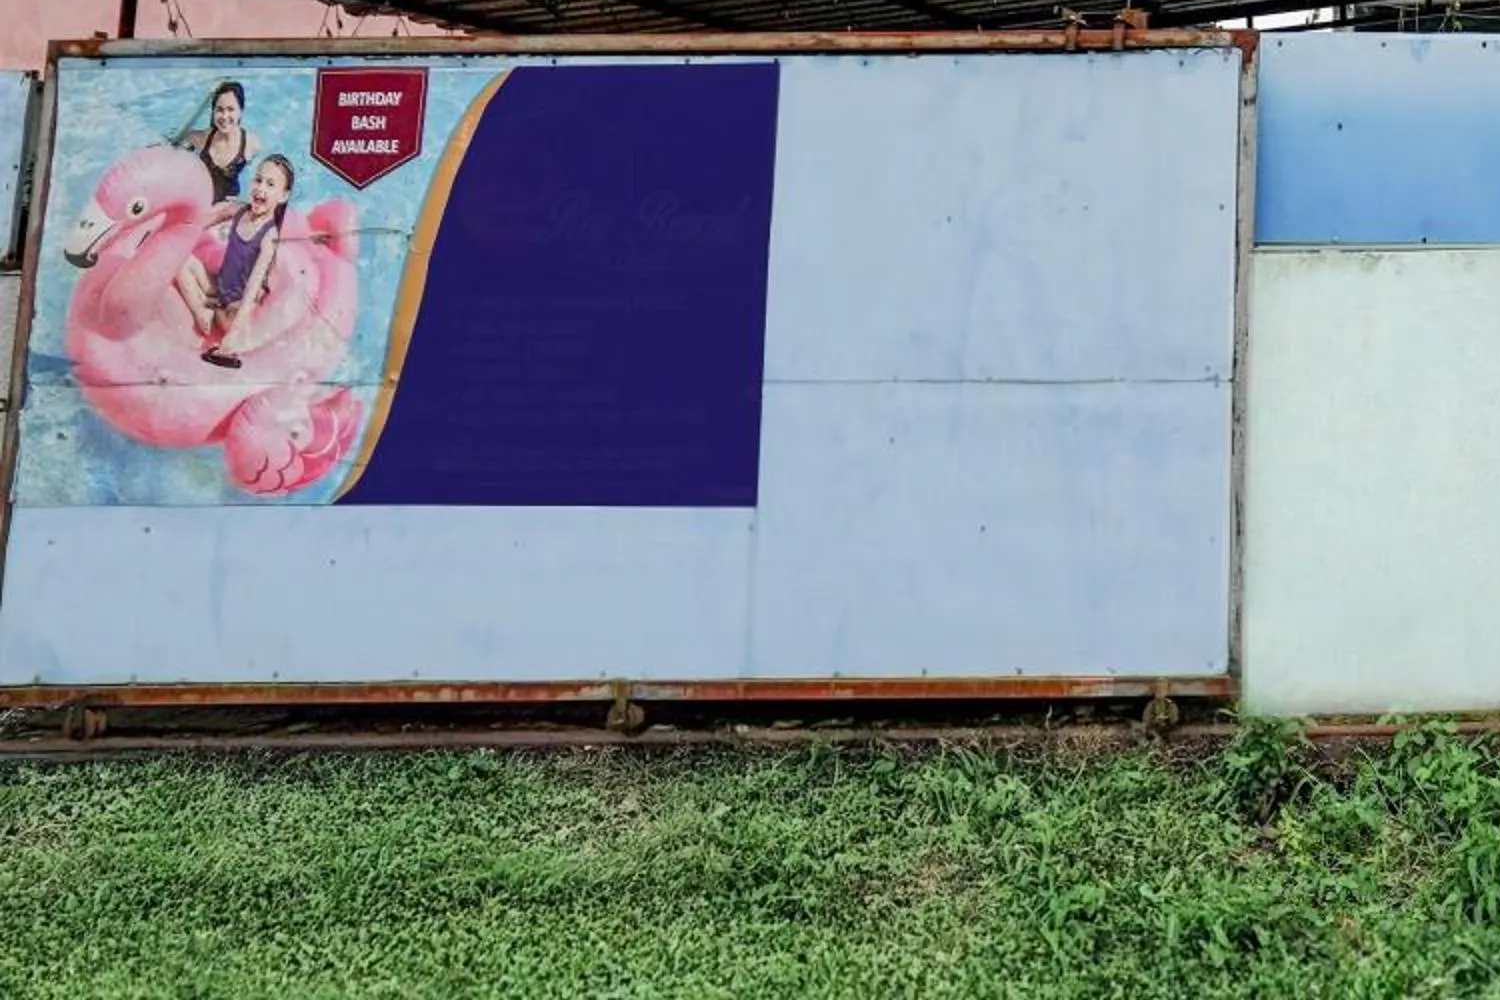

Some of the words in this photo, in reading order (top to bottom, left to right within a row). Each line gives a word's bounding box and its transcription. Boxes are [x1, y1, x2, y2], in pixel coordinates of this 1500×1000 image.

[337, 91, 403, 107] BIRTHDAY
[351, 115, 387, 130] BASH
[331, 139, 400, 154] AVAILABLE
